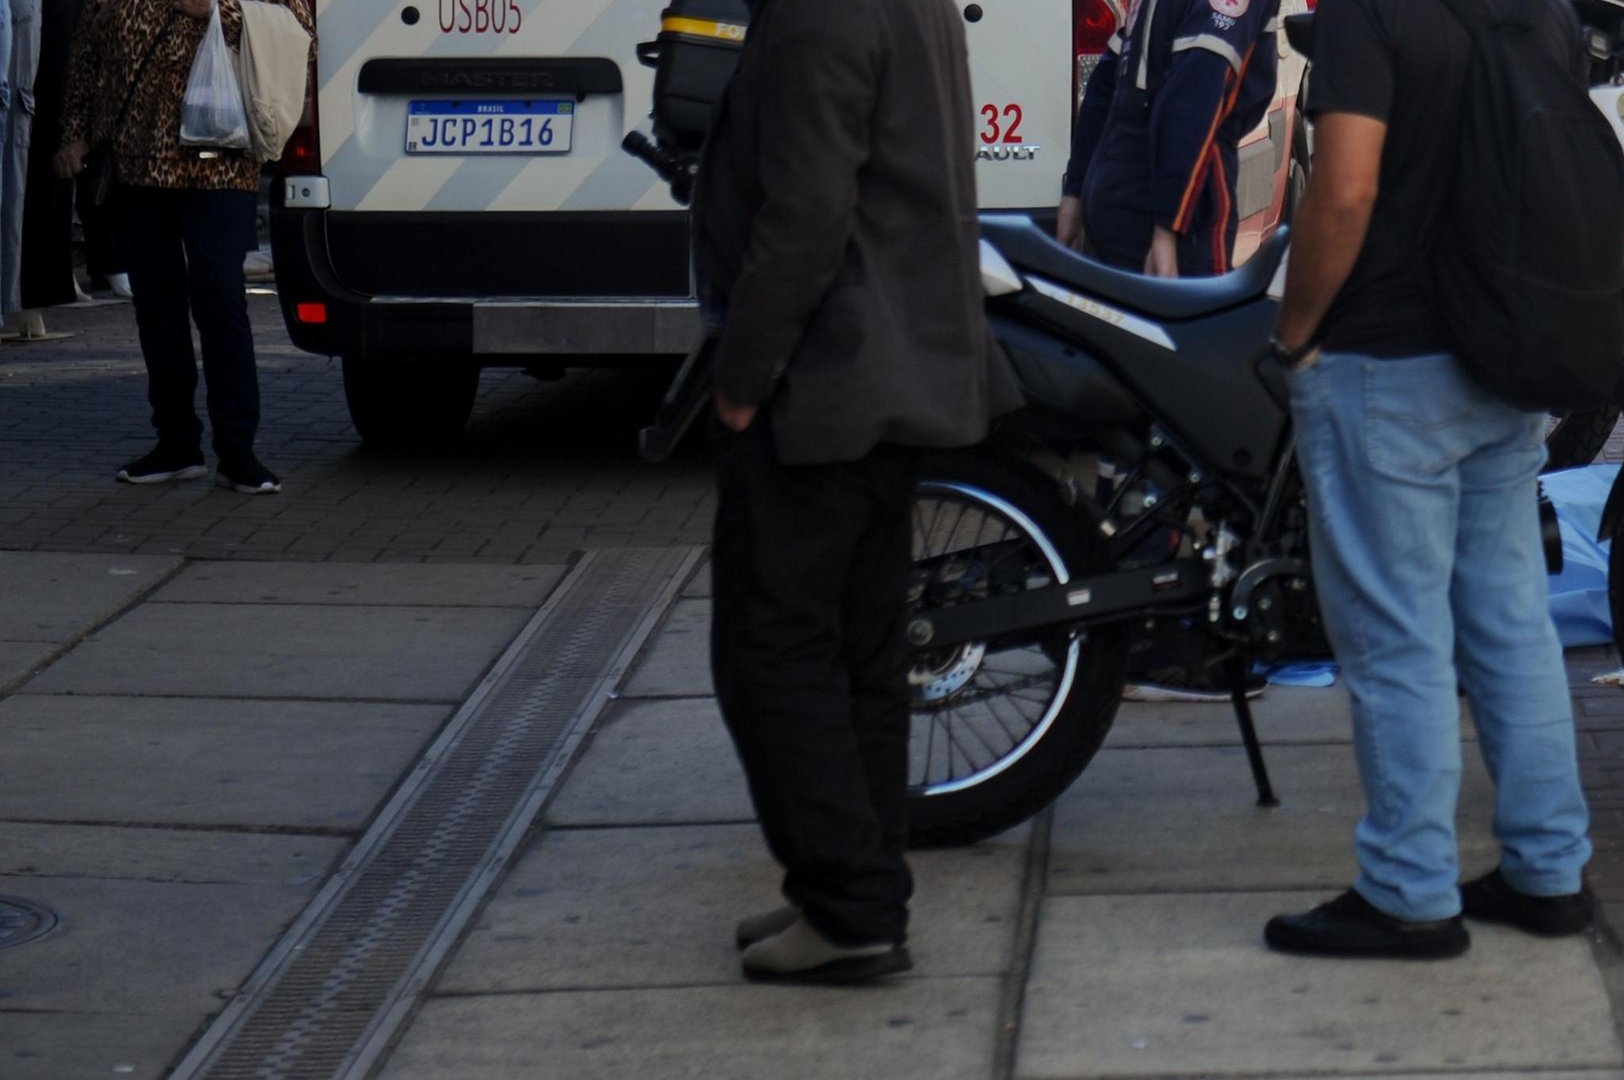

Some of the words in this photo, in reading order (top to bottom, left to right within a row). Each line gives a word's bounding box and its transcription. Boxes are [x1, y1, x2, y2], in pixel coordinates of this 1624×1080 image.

[477, 105, 504, 114] BRASIL
[422, 118, 554, 147] JCP1B16
[980, 103, 1023, 145] 32
[408, 141, 418, 151] BR
